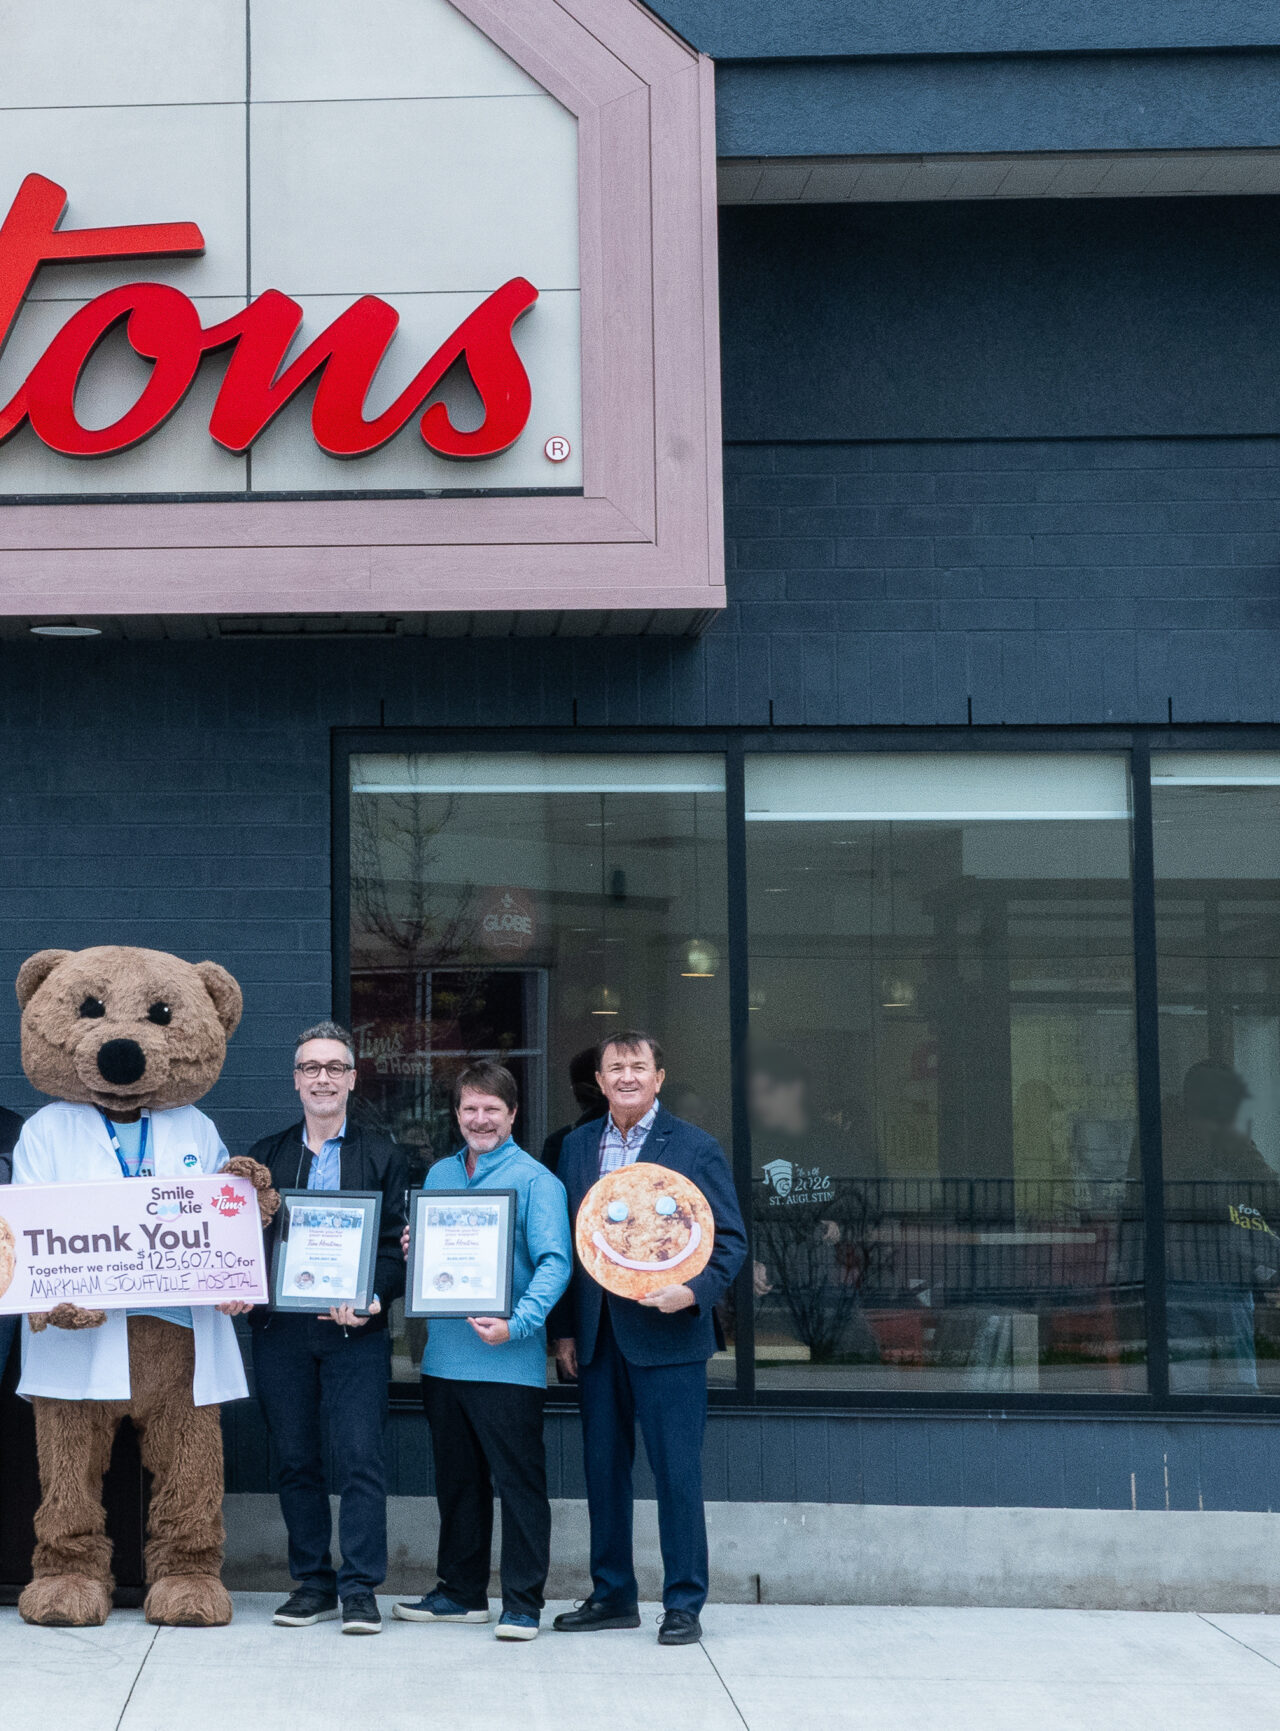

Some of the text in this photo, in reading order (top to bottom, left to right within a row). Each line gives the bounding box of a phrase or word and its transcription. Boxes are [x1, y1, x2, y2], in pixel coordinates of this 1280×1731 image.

[795, 1175, 831, 1191] 2026
[146, 1201, 202, 1216] Cookie
[151, 1185, 244, 1211] Smile Tims
[769, 1195, 784, 1206] ST.
[22, 1221, 211, 1257] Thank You!
[28, 1263, 83, 1278] Together
[86, 1265, 103, 1273] we
[106, 1260, 144, 1272] raised
[237, 1256, 255, 1268] for
[30, 1270, 258, 1299] MARKHAM STOUFFVILLE HOSPITAL
